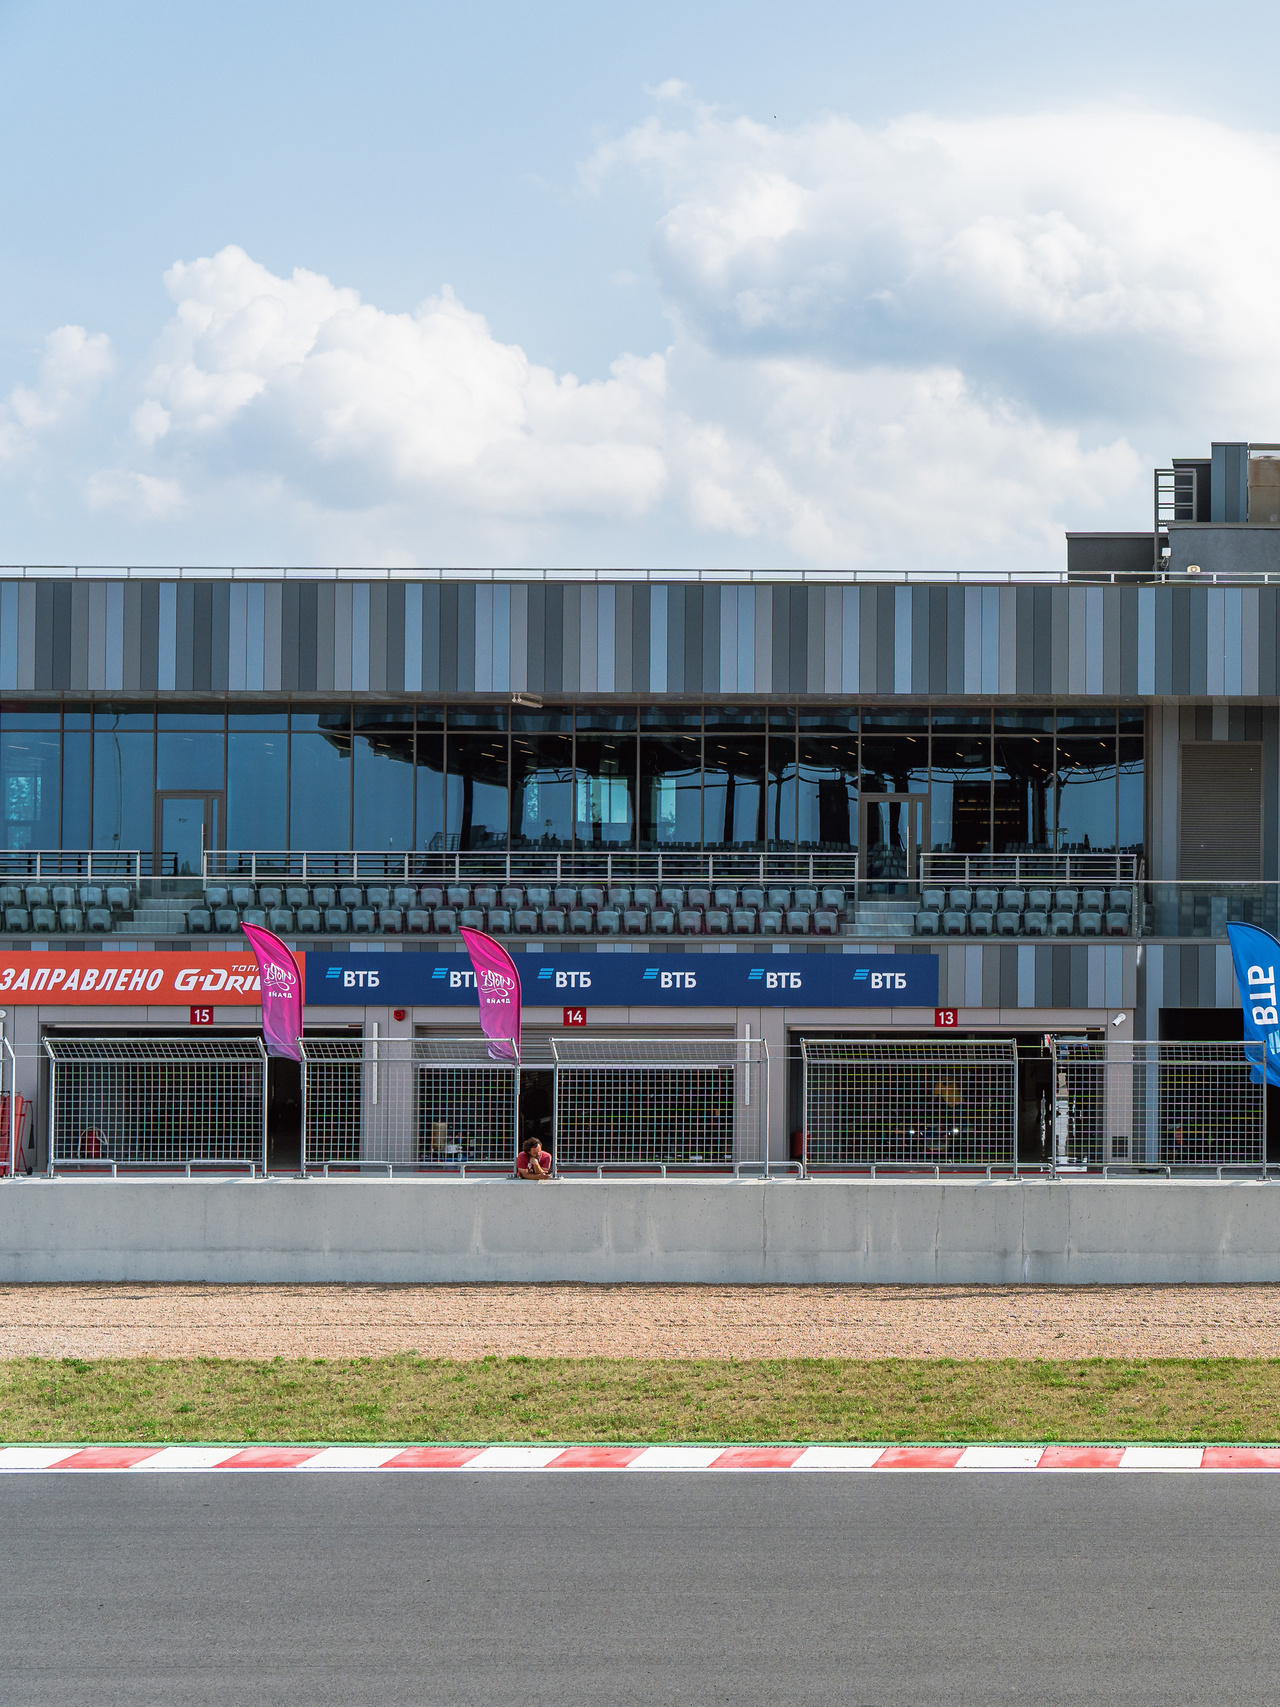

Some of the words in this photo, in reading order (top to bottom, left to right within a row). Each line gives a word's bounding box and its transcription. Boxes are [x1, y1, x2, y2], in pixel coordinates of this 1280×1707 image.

[0, 968, 164, 991] ЗАПРАВЛЕНО
[343, 970, 380, 988] ВТБ
[555, 971, 592, 988] ВТБ
[660, 971, 697, 988] ВТБ
[766, 972, 802, 989] ВТБ
[871, 972, 907, 989] ВТБ
[194, 1009, 210, 1023] 15
[566, 1010, 583, 1024] 14
[938, 1011, 954, 1025] 13
